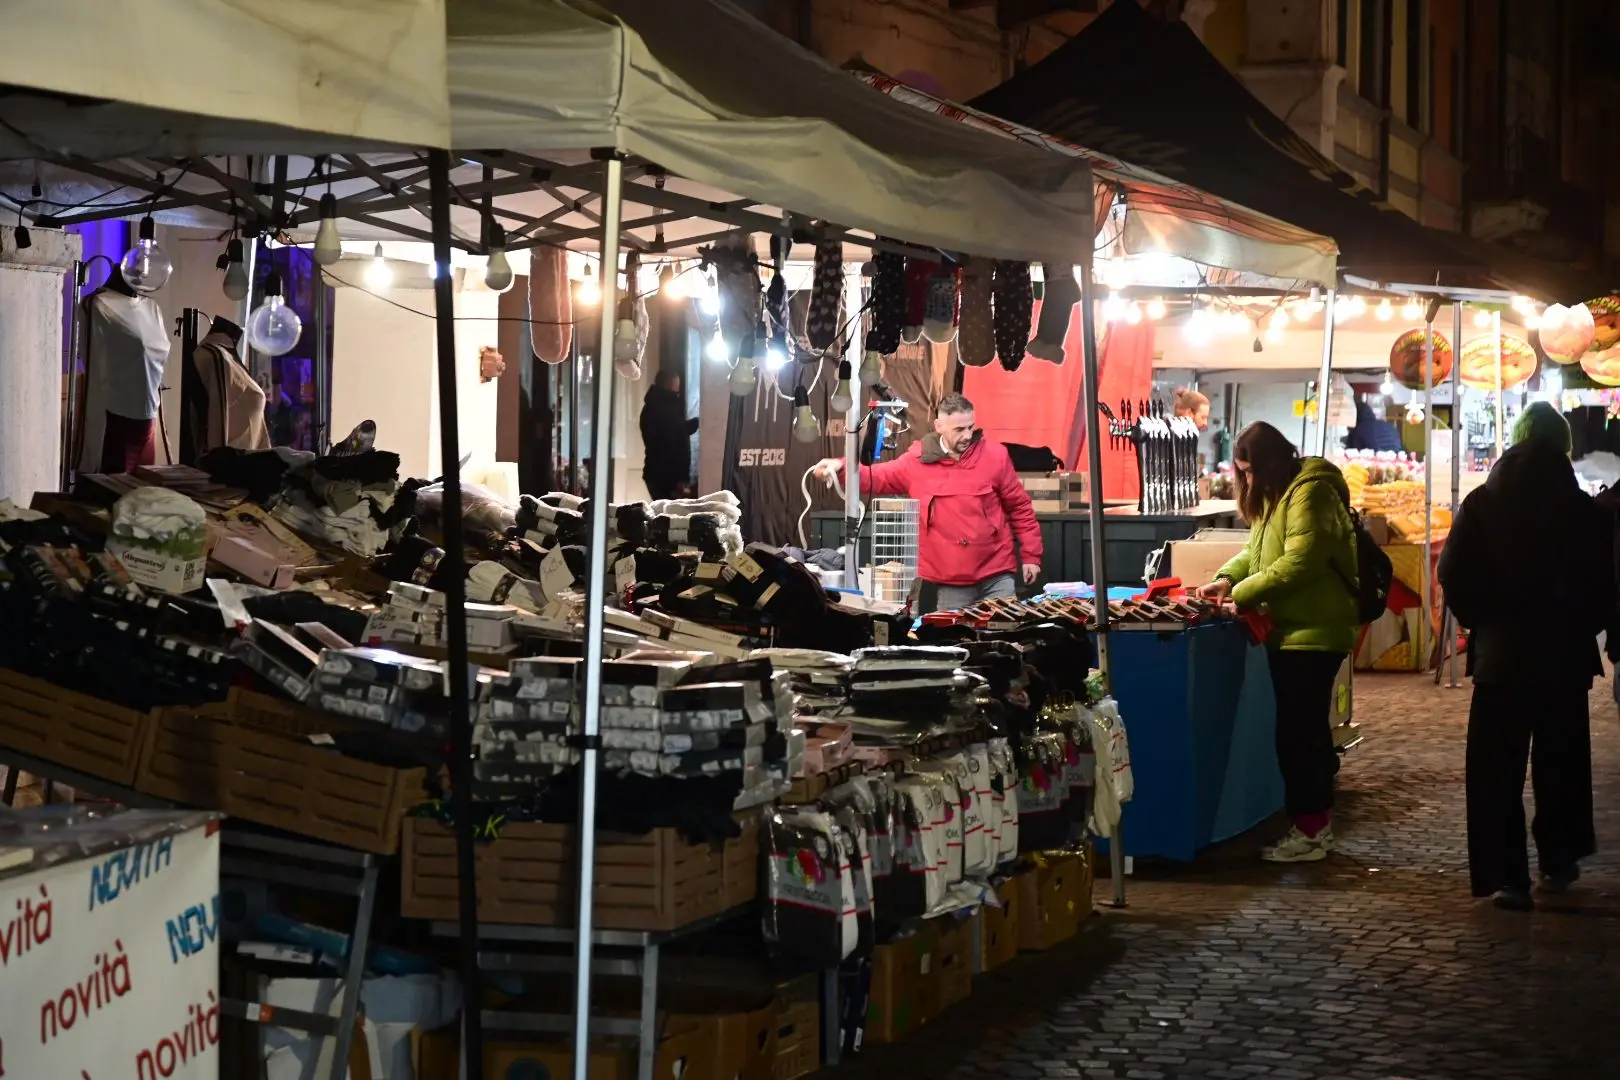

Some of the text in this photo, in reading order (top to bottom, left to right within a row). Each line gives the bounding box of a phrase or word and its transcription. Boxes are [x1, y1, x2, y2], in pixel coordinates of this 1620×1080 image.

[739, 448, 785, 466] EST 2013
[0, 883, 52, 966] vità
[165, 893, 219, 964] NOV
[40, 938, 132, 1044] novità
